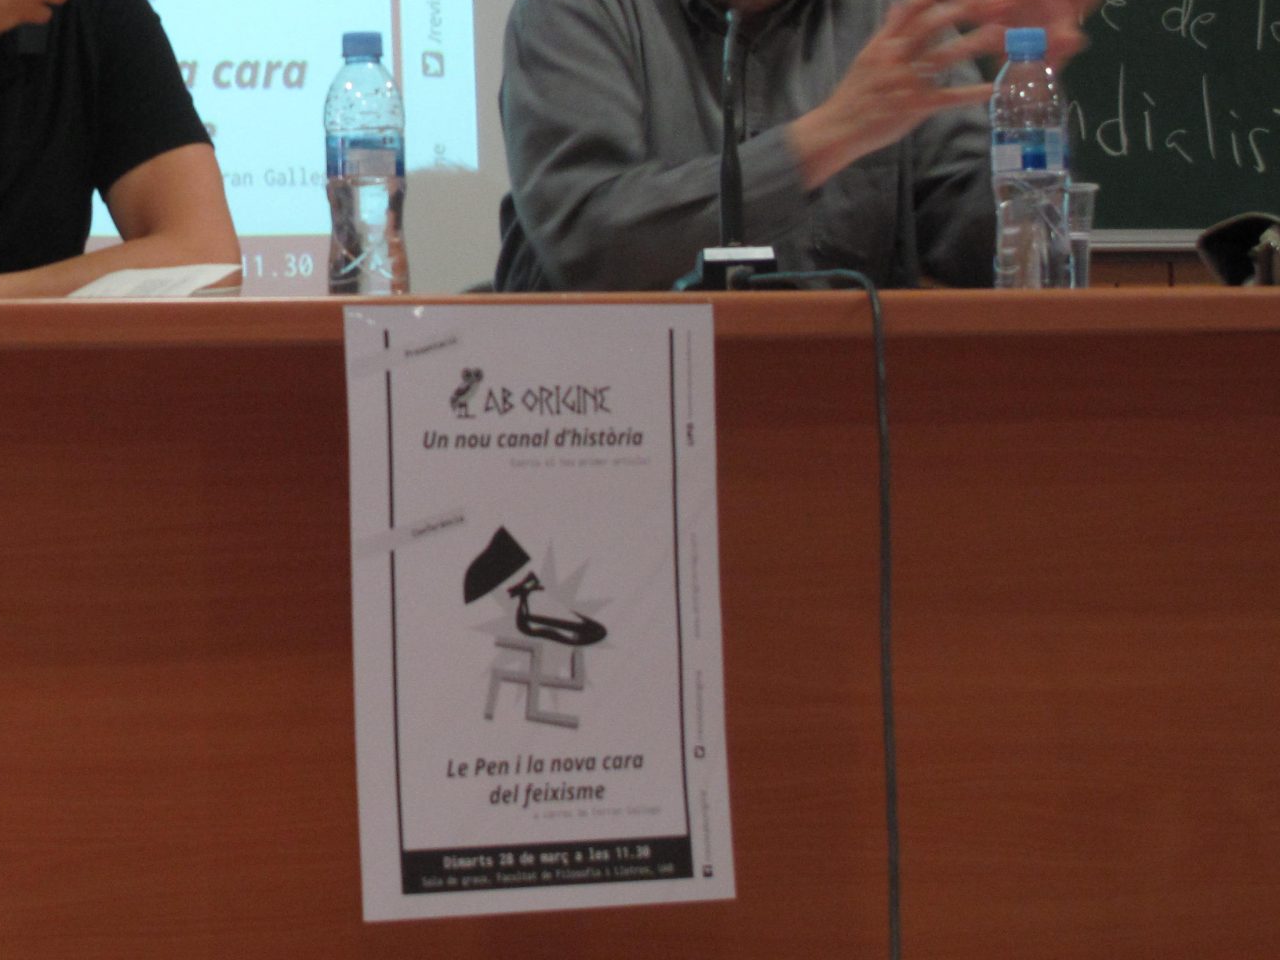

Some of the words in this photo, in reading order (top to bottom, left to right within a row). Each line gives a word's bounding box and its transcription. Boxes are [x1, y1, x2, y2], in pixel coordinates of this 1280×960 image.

[212, 58, 308, 90] cara
[484, 387, 514, 415] AB
[521, 385, 612, 415] ORIGINE
[423, 430, 448, 450] Un
[454, 433, 491, 449] nou
[498, 429, 549, 449] canal
[554, 426, 644, 447] d'història
[446, 758, 468, 778] Le
[474, 756, 510, 776] Pen
[527, 754, 544, 774] la
[550, 757, 597, 774] nova
[602, 753, 644, 771] cara
[489, 785, 520, 805] del
[523, 783, 606, 808] feixisme
[520, 851, 536, 864] de
